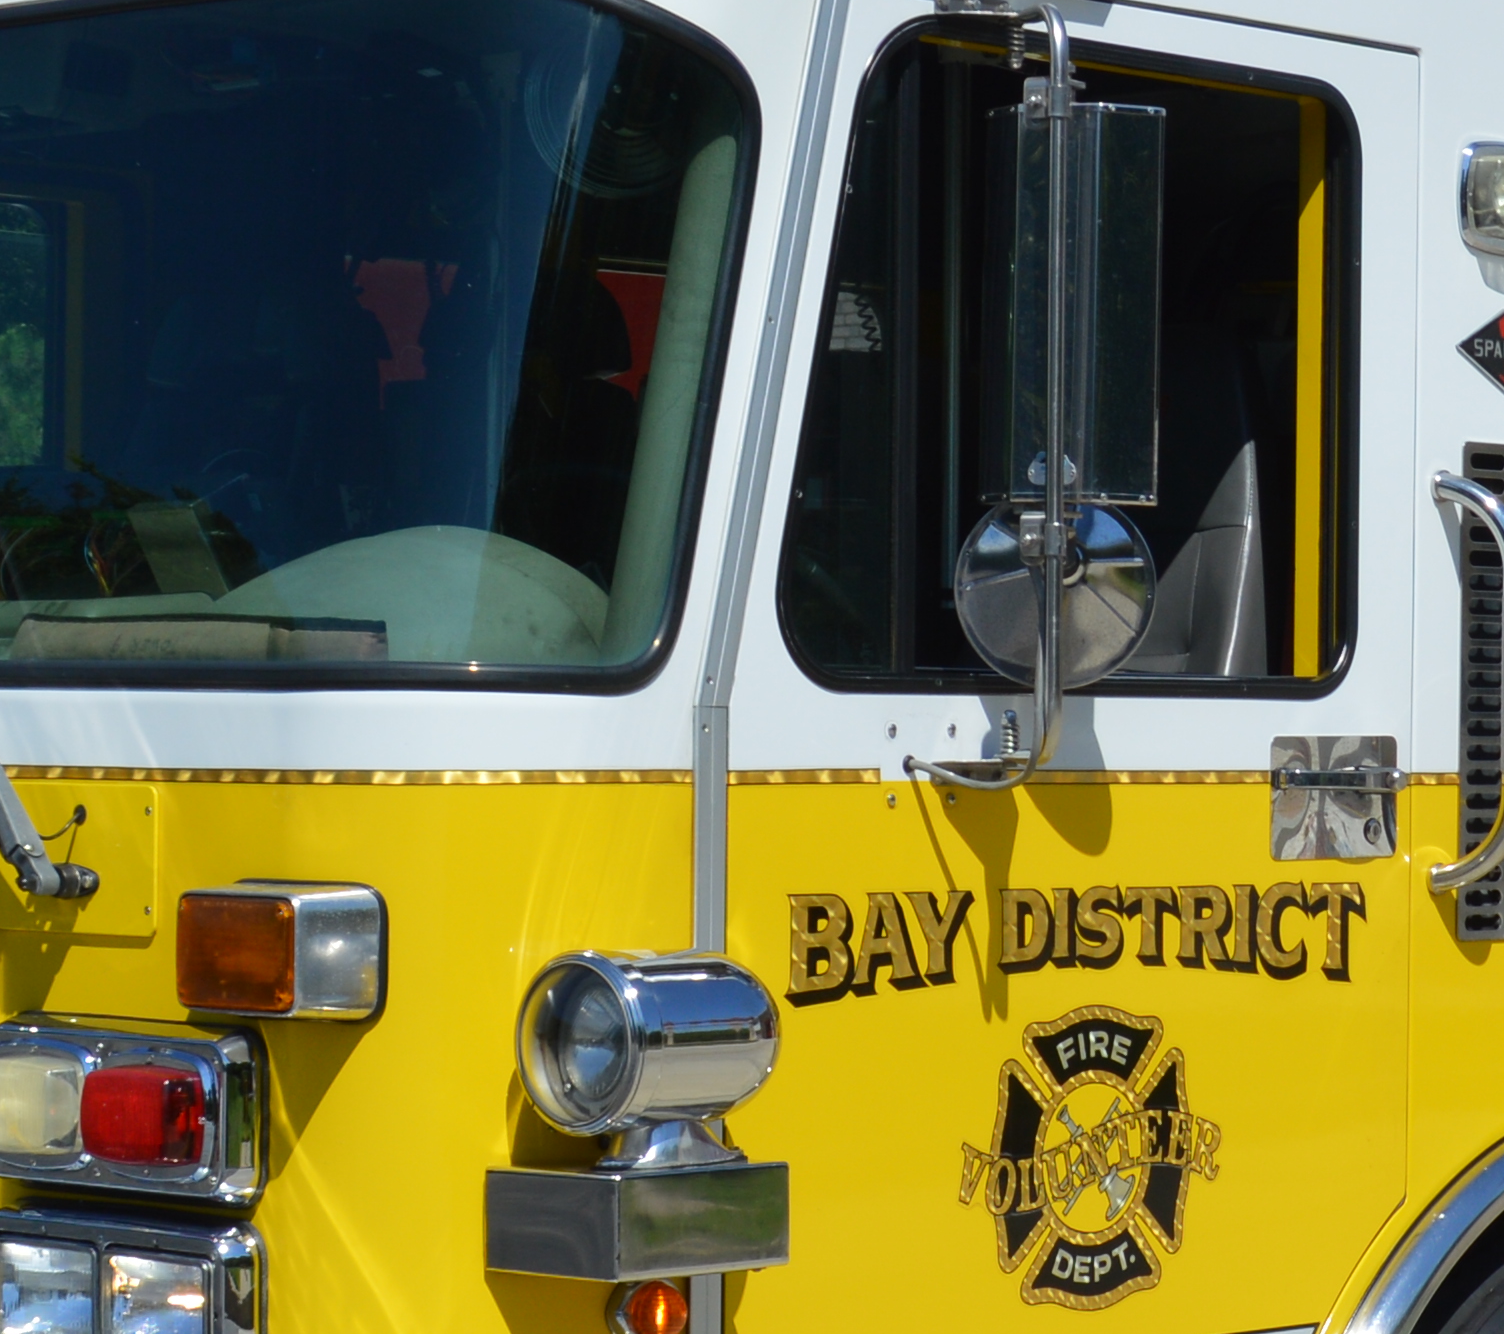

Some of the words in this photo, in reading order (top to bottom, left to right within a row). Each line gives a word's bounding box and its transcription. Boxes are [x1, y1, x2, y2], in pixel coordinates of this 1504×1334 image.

[783, 890, 974, 1007] BAY
[998, 880, 1367, 982] DISTRICT
[1055, 1030, 1132, 1070] FIRE
[958, 1108, 1223, 1218] VOLUNTEER
[1051, 1241, 1136, 1284] DEPT.
